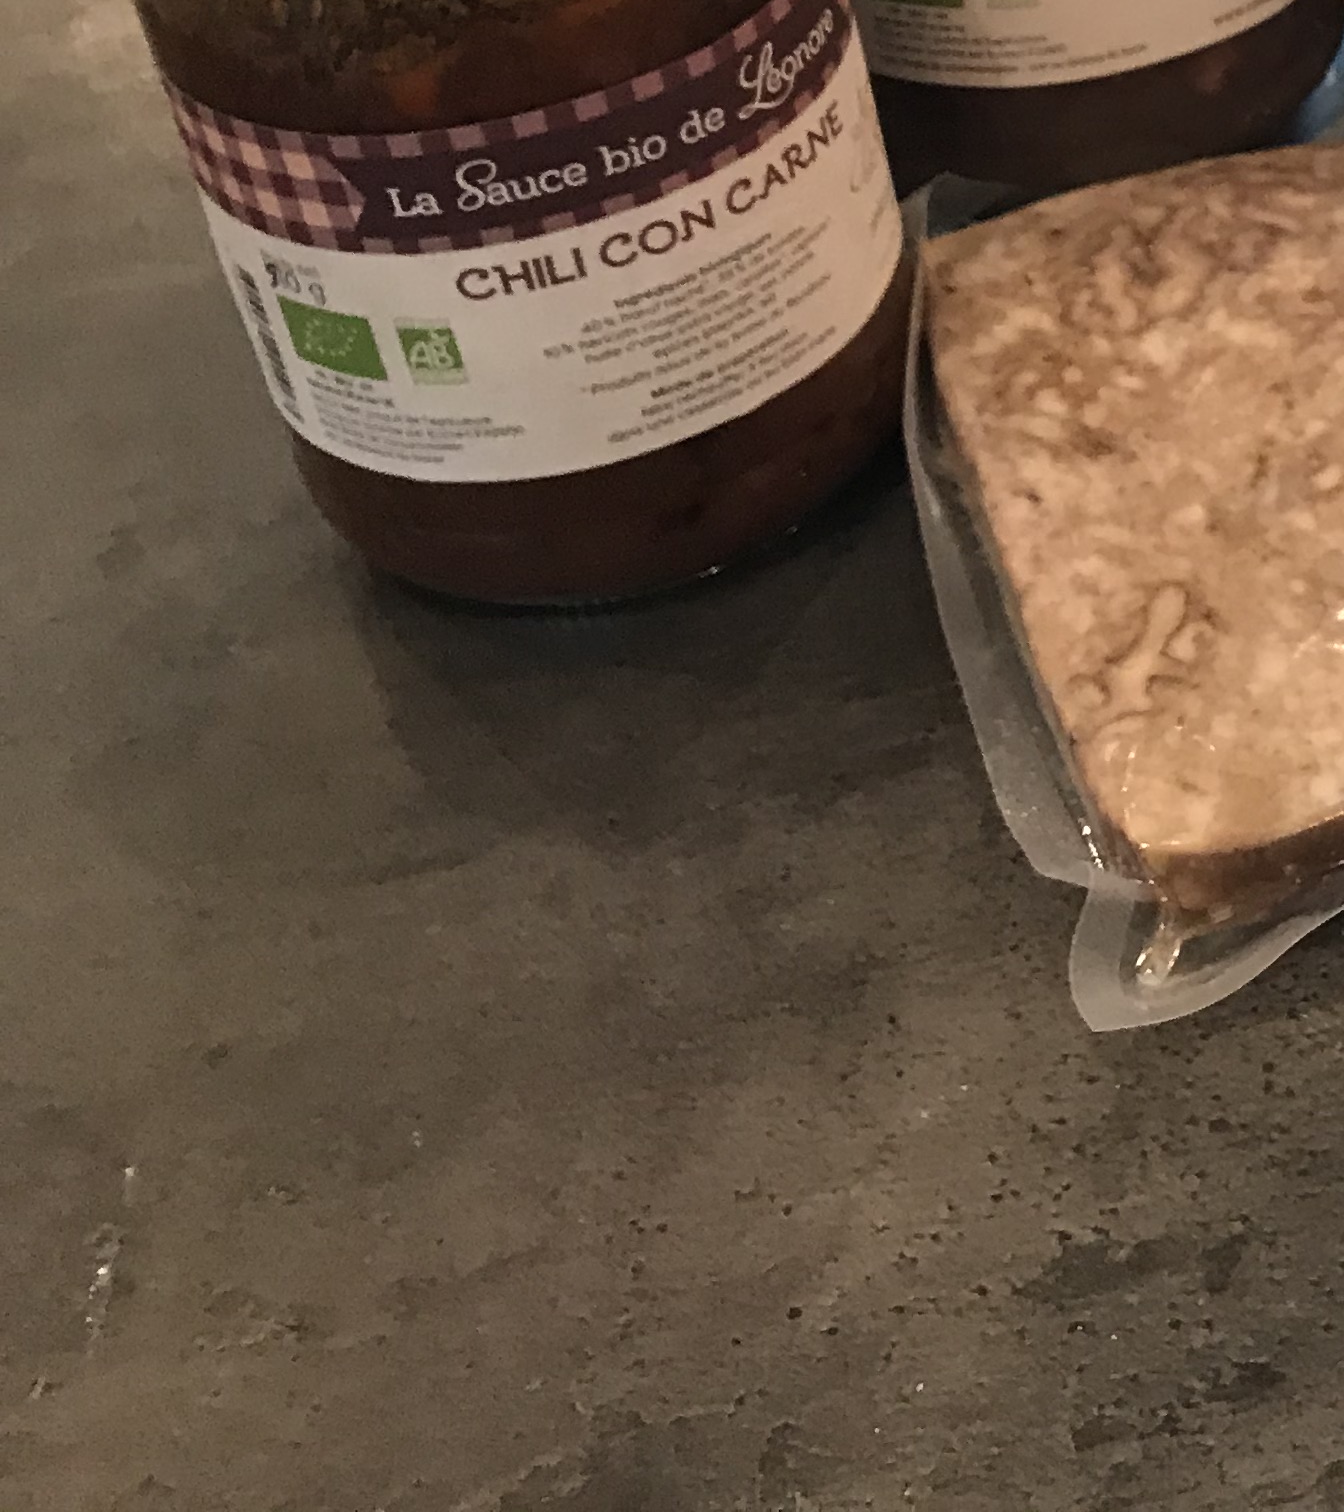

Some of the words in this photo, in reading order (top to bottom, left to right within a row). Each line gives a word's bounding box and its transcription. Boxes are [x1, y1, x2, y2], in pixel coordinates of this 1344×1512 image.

[386, 187, 443, 218] La
[455, 158, 588, 212] Sauce
[599, 133, 667, 176] bio
[680, 106, 726, 144] de
[455, 246, 588, 301] CHILI
[599, 199, 717, 268] CON
[726, 99, 844, 215] CARNE
